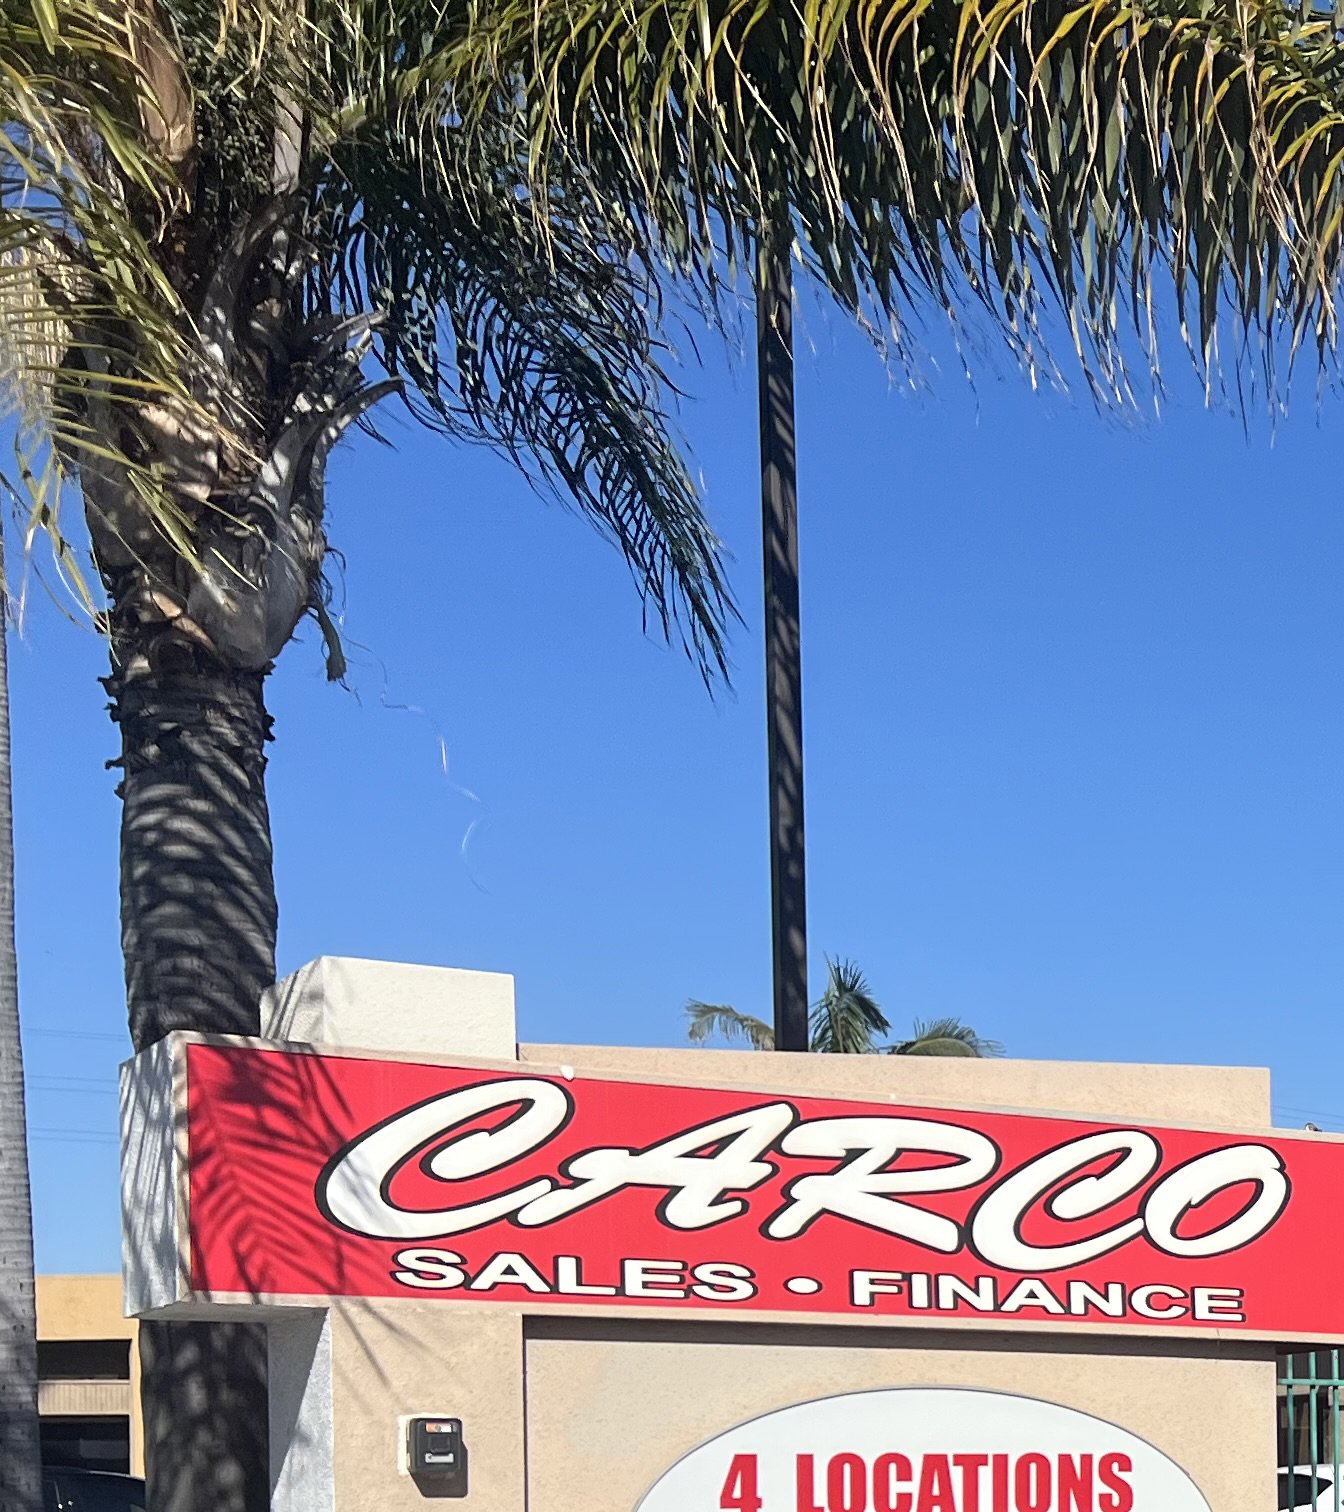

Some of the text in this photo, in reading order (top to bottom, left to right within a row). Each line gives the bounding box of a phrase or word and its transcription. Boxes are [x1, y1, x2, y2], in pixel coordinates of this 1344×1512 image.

[315, 1076, 1292, 1273] CARCO
[391, 1248, 1246, 1323] SALES FINANCE
